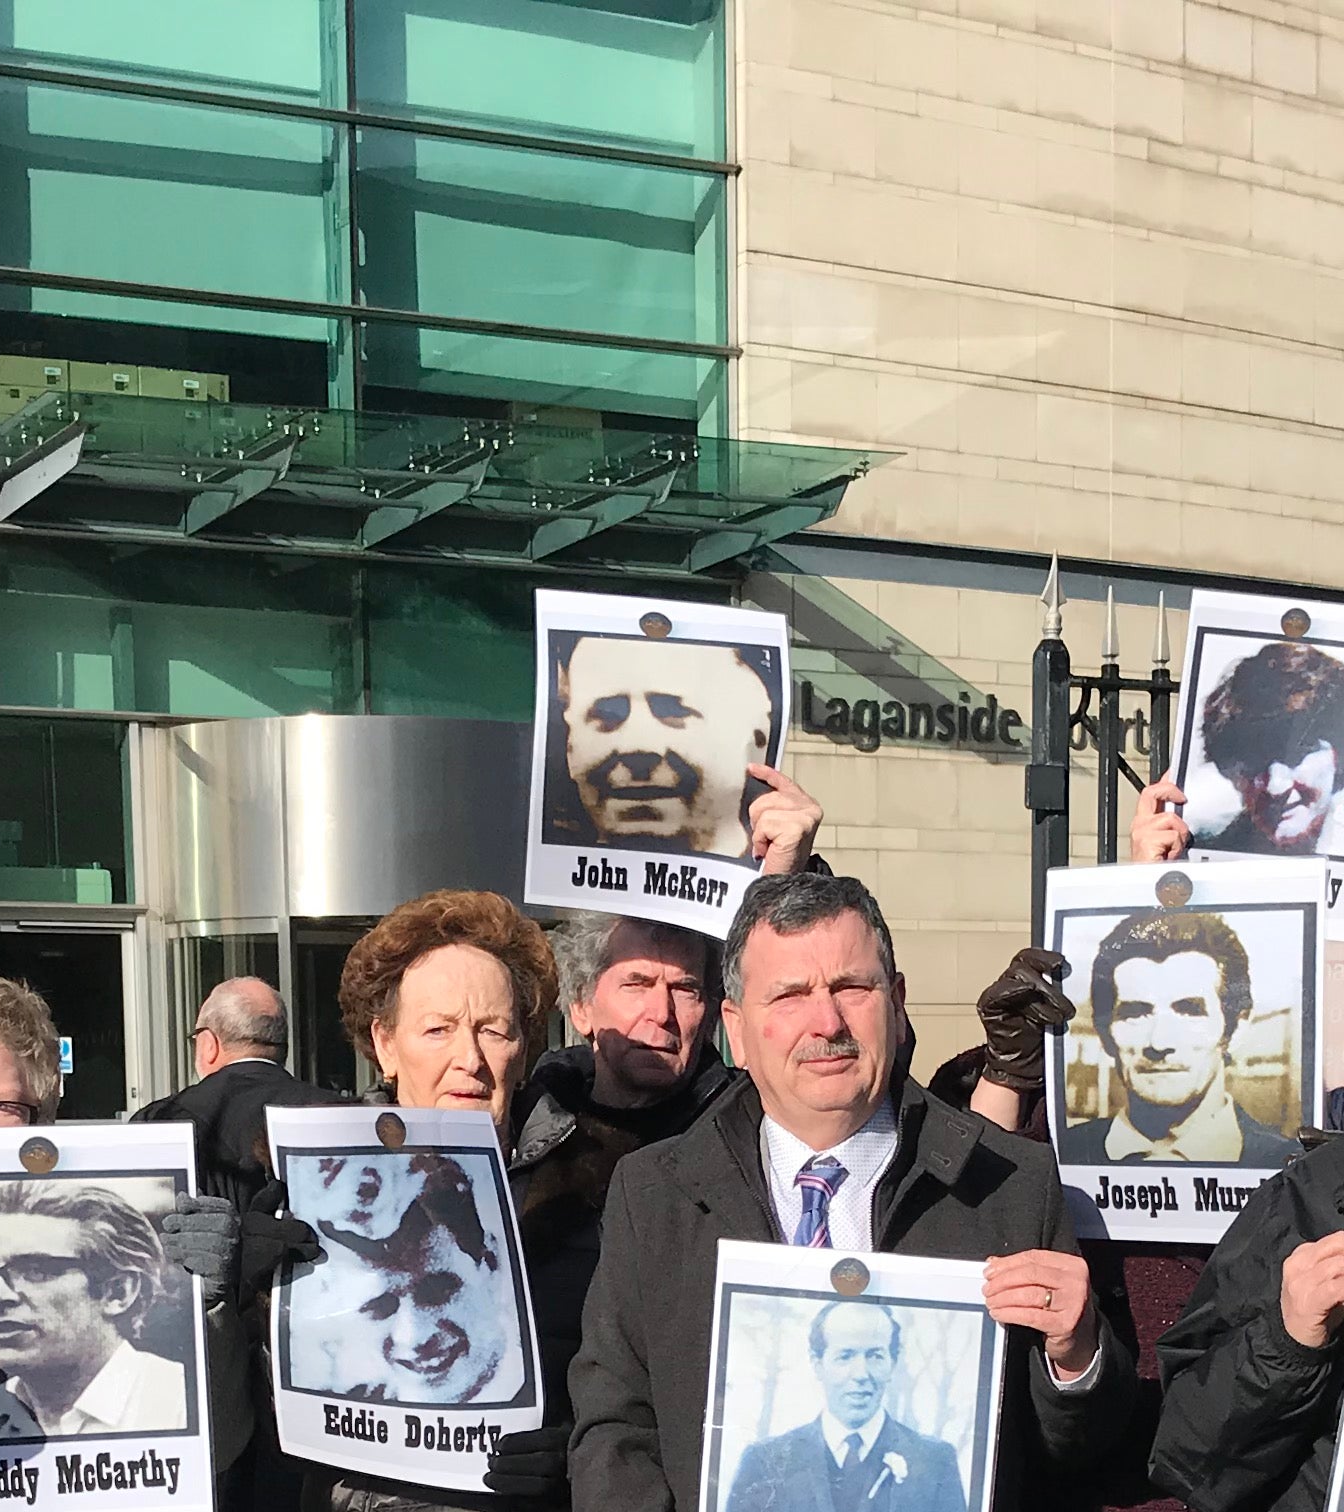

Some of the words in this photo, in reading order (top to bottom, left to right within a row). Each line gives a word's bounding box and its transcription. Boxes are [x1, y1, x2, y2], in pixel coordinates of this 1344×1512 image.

[801, 679, 1024, 752] Laganside
[572, 856, 628, 891] John
[643, 861, 729, 908] McKerr
[1095, 1176, 1178, 1217] Joseph
[1193, 1177, 1268, 1212] Mur
[323, 1403, 388, 1444] Eddie
[405, 1415, 501, 1456] Doherty
[56, 1449, 180, 1494] McCarthy
